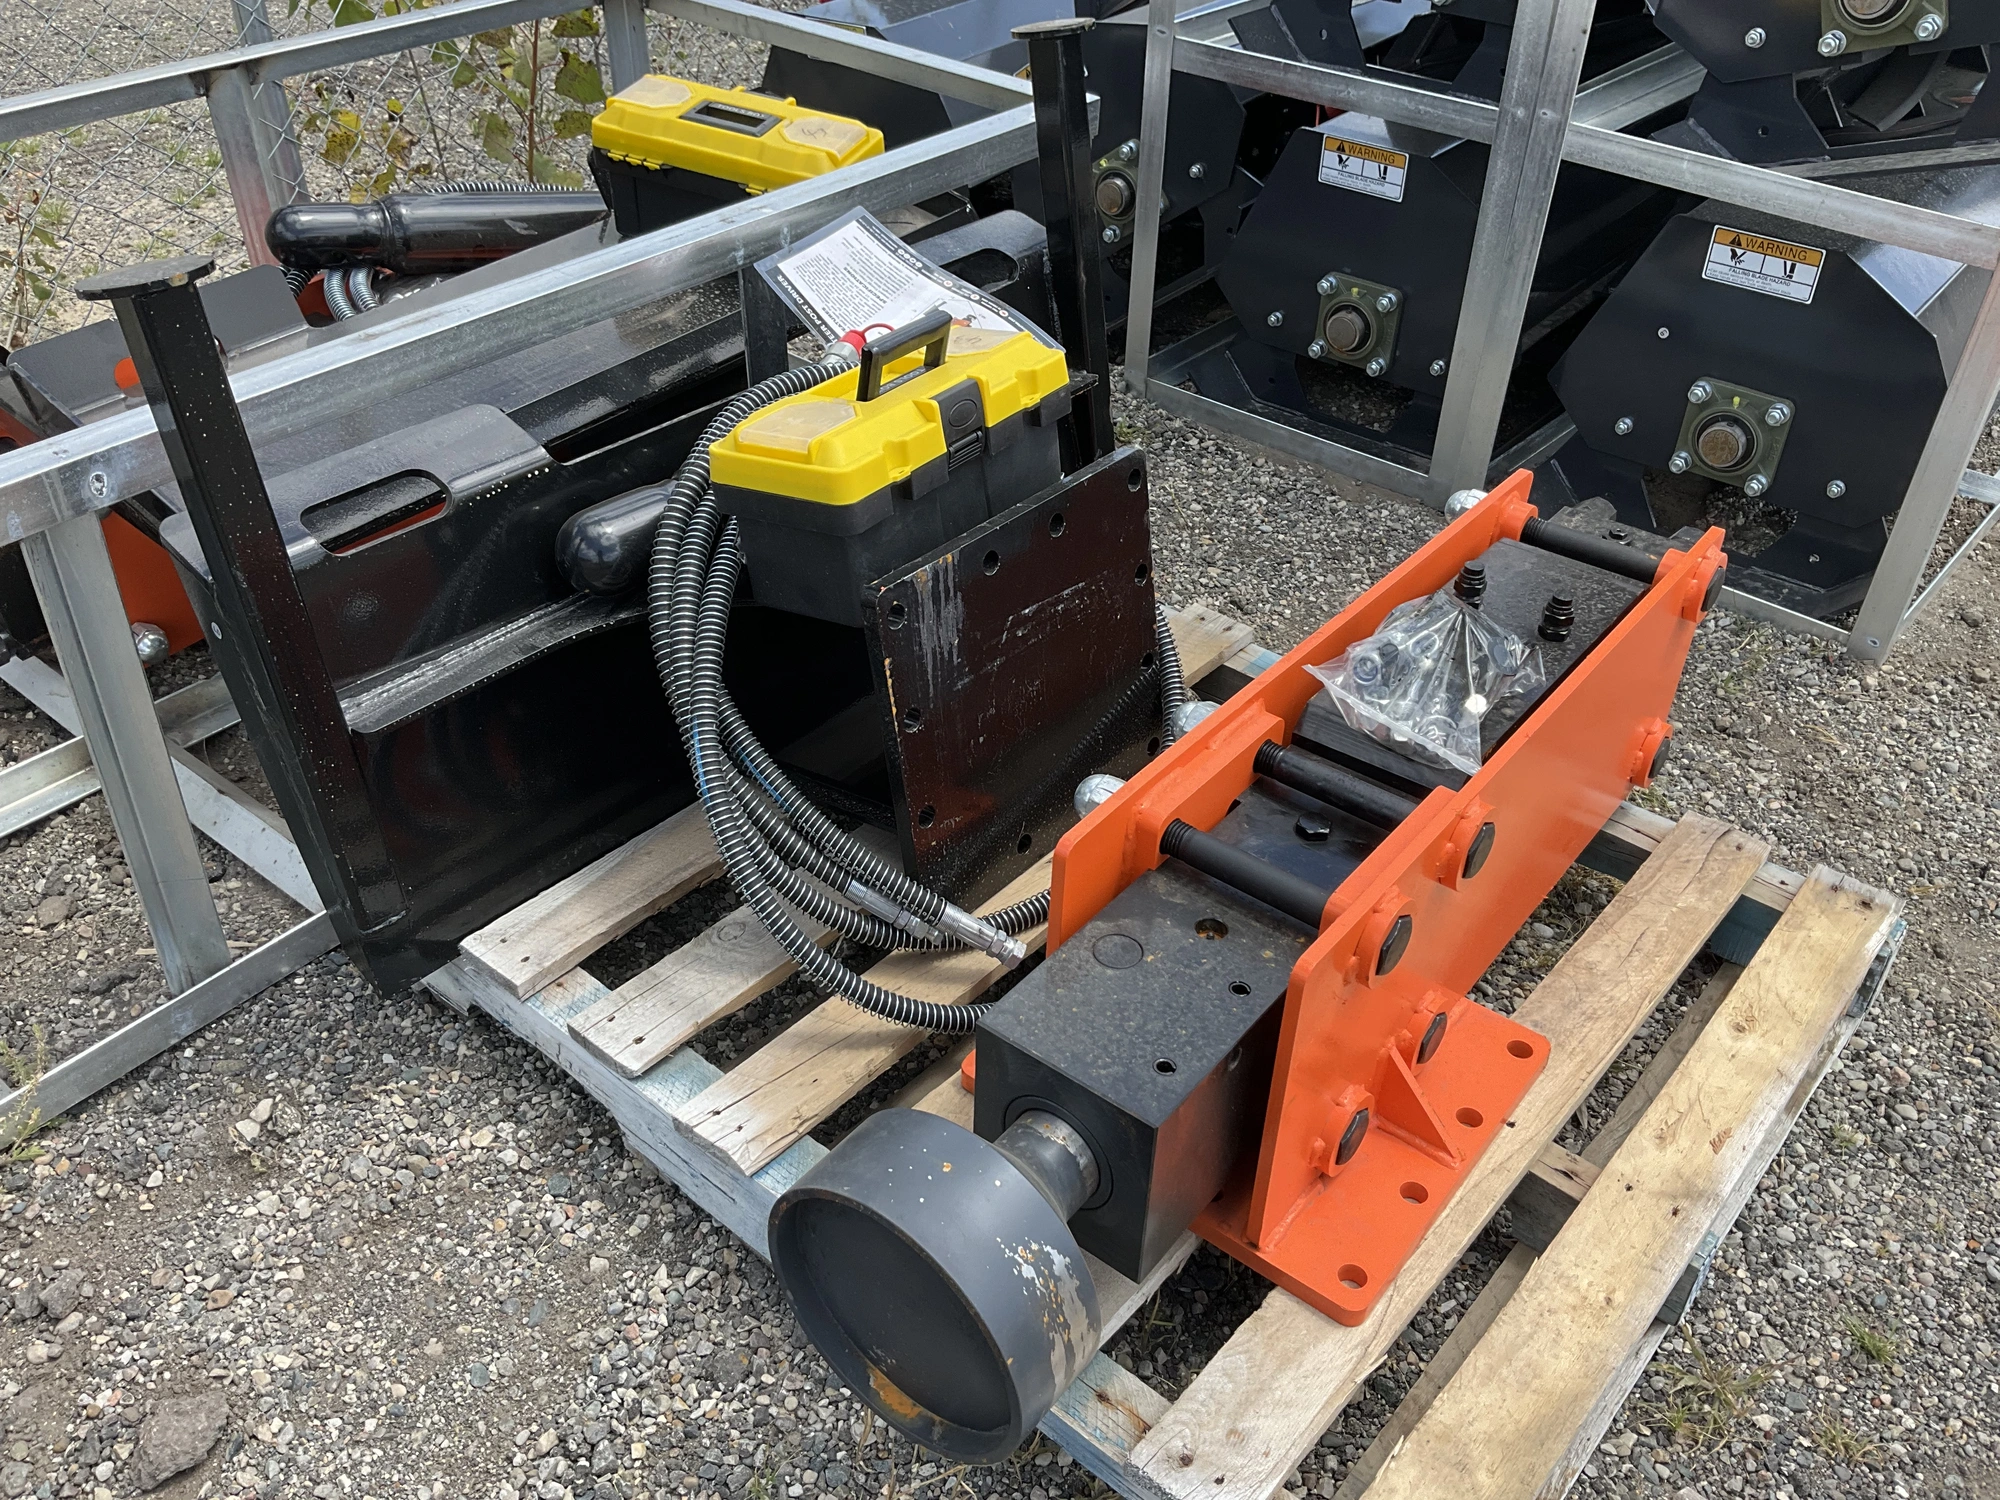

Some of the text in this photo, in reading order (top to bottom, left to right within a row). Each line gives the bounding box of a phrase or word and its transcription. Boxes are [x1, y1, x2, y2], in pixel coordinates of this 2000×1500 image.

[1348, 144, 1395, 164] WARNING
[1337, 172, 1354, 180] FALLING
[1746, 237, 1808, 261] WARNING
[843, 266, 887, 304] SPECIFICATIONS
[1728, 268, 1791, 286] FALLING BLADE HAZARD
[777, 274, 838, 344] TEER POST DRIVER
